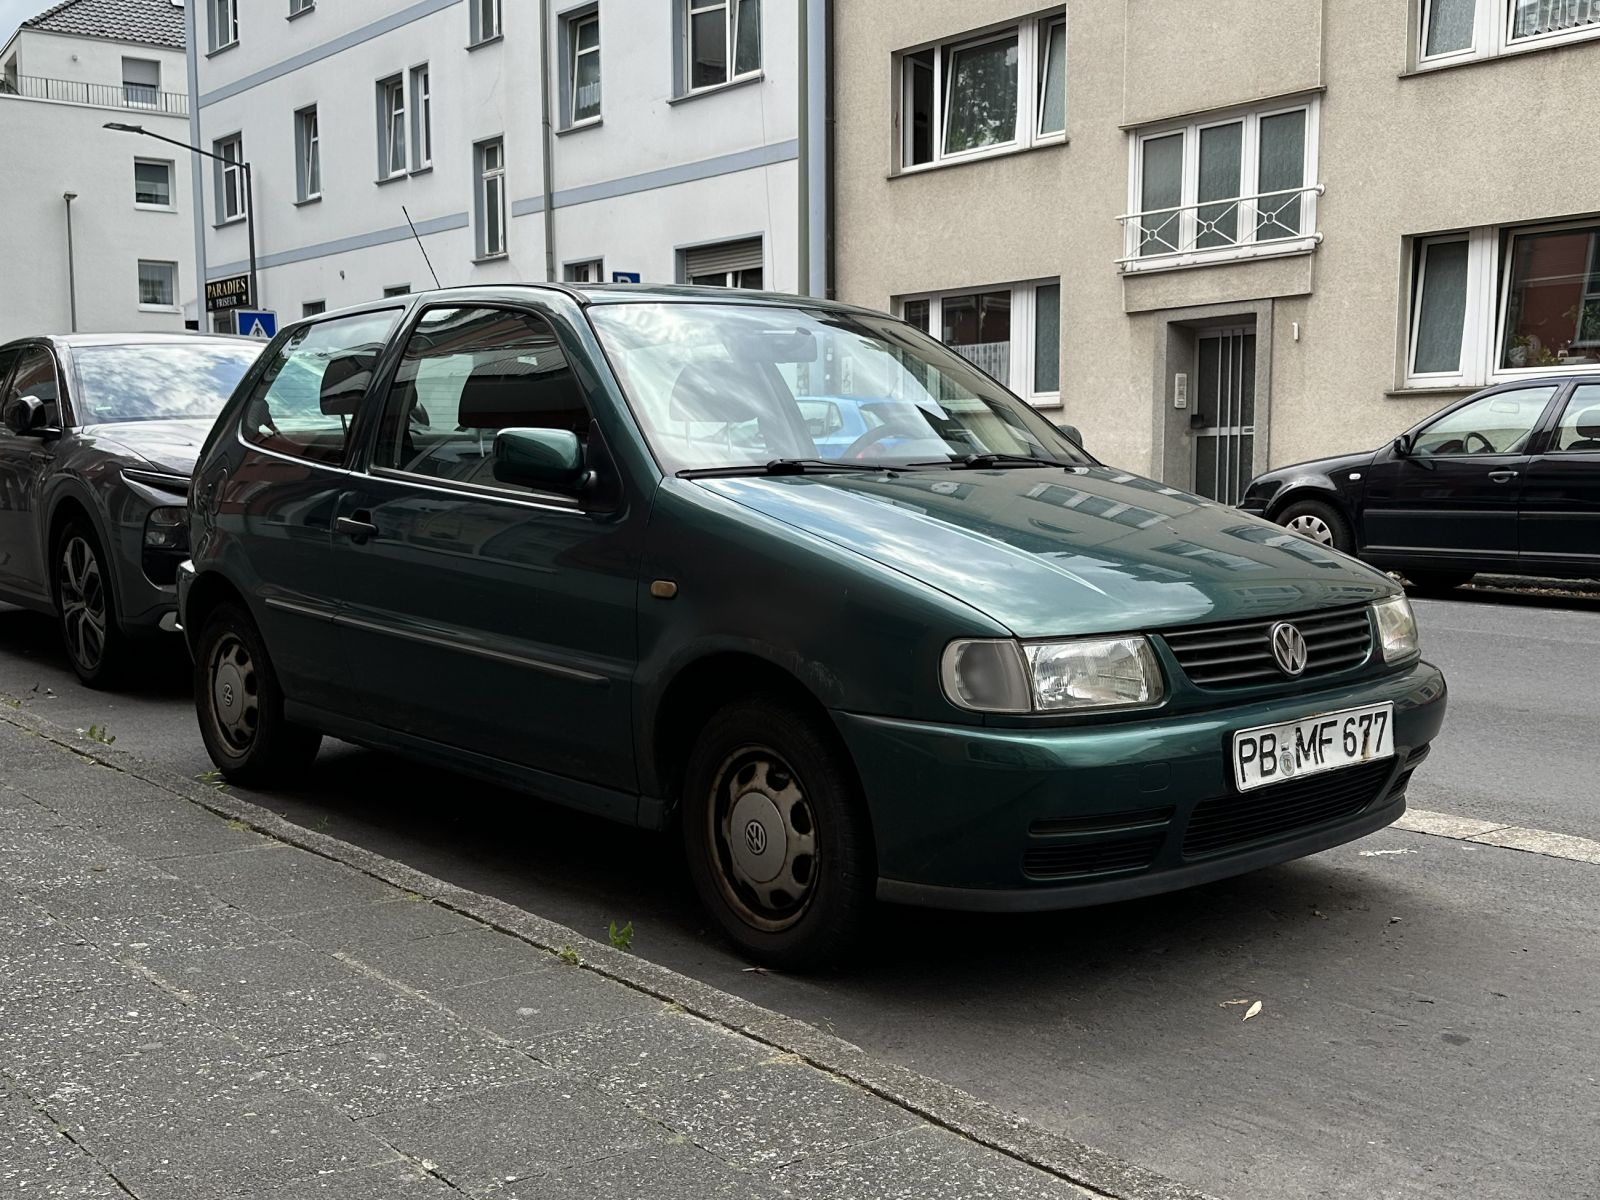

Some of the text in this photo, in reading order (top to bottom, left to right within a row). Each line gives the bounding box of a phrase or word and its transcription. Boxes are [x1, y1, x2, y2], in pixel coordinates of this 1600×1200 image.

[206, 278, 246, 299] PARADIES
[215, 295, 238, 308] FRISEUR
[1273, 623, 1307, 675] VW
[1239, 710, 1388, 783] PB MF 677
[745, 820, 766, 855] VW
